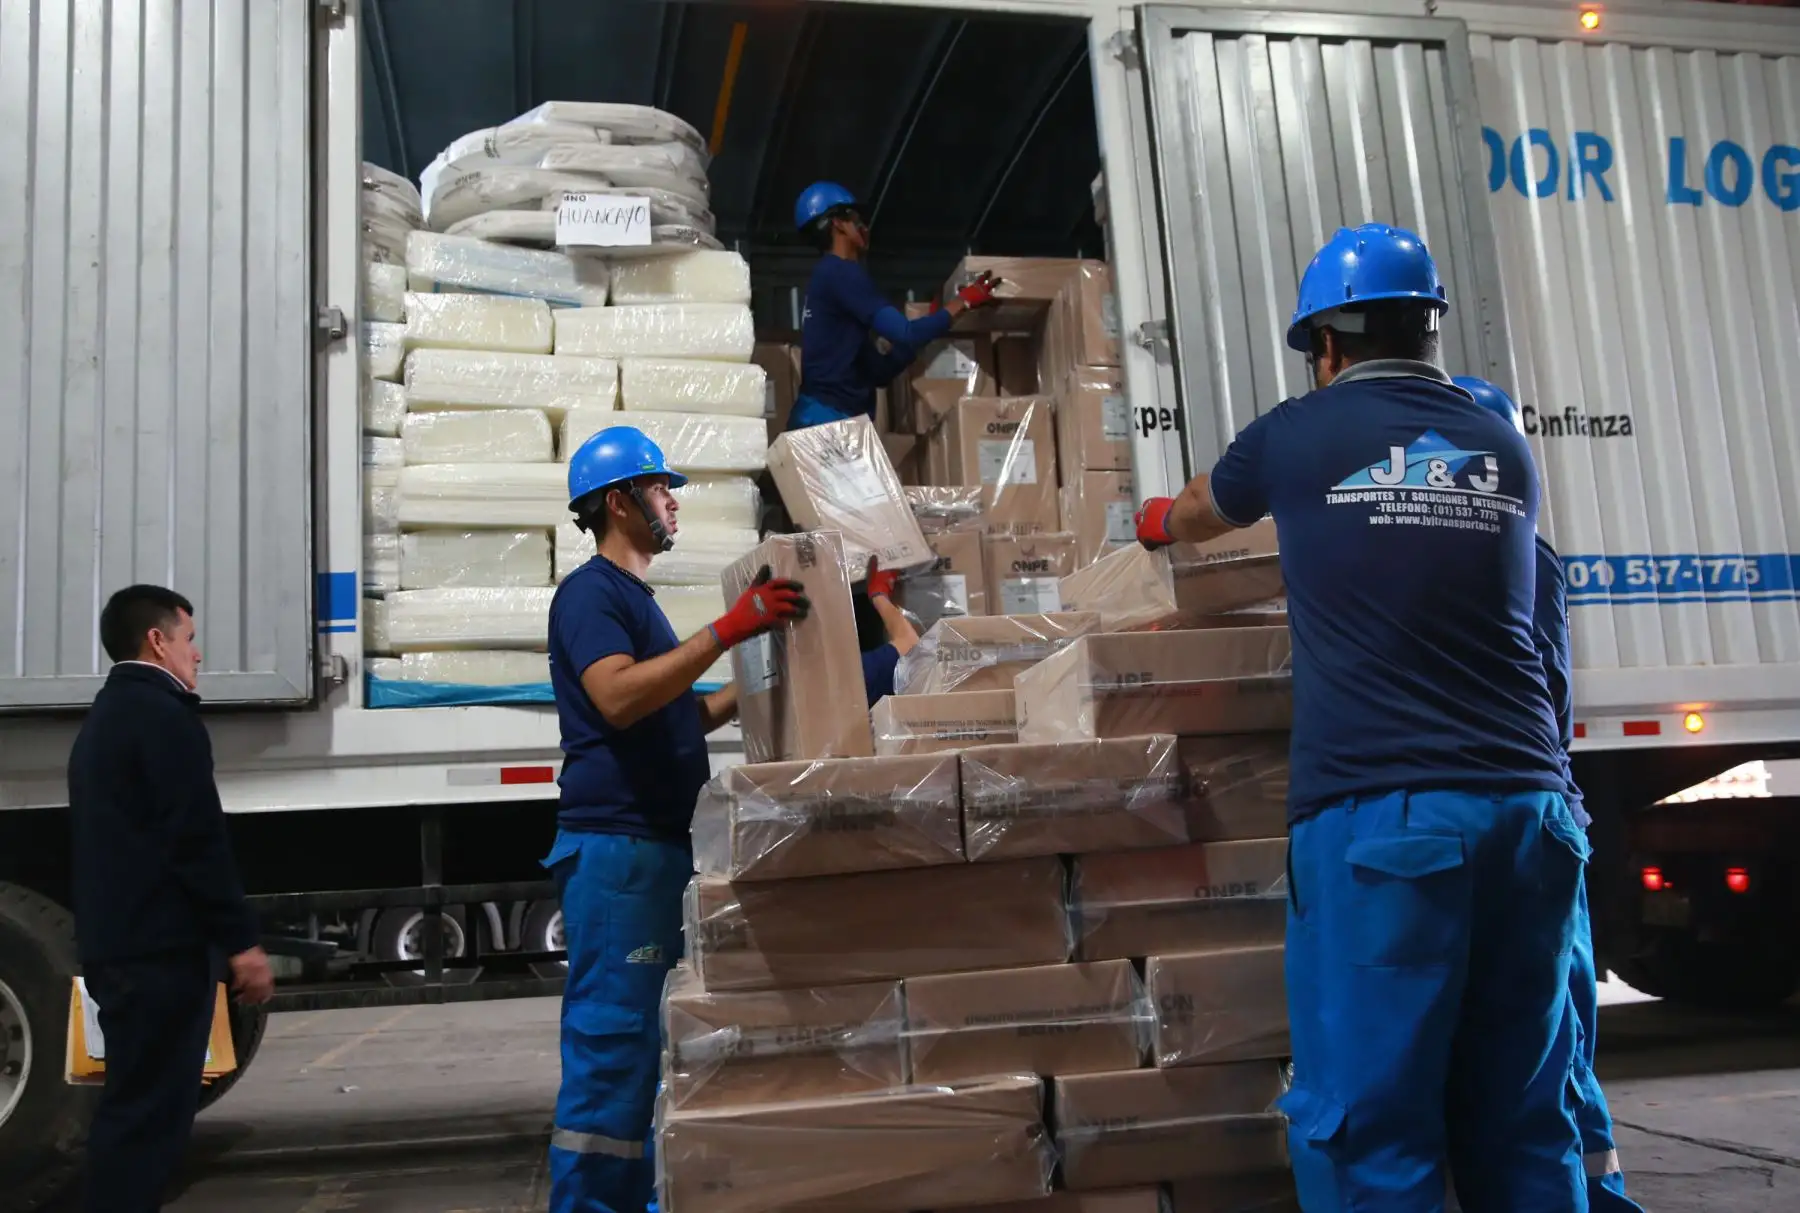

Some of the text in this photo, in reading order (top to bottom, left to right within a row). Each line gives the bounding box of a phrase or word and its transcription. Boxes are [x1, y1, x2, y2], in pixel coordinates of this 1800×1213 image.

[1666, 136, 1800, 212] LOG
[558, 204, 647, 234] HUANCAYO
[1368, 446, 1499, 492] J & J
[1326, 491, 1395, 504] TRANSPORTES
[1399, 491, 1407, 501] Y
[1411, 492, 1468, 505] SOLUCIONES
[1011, 560, 1048, 572] ONPE
[1567, 560, 1615, 587] 01)
[1194, 880, 1260, 900] ONPE
